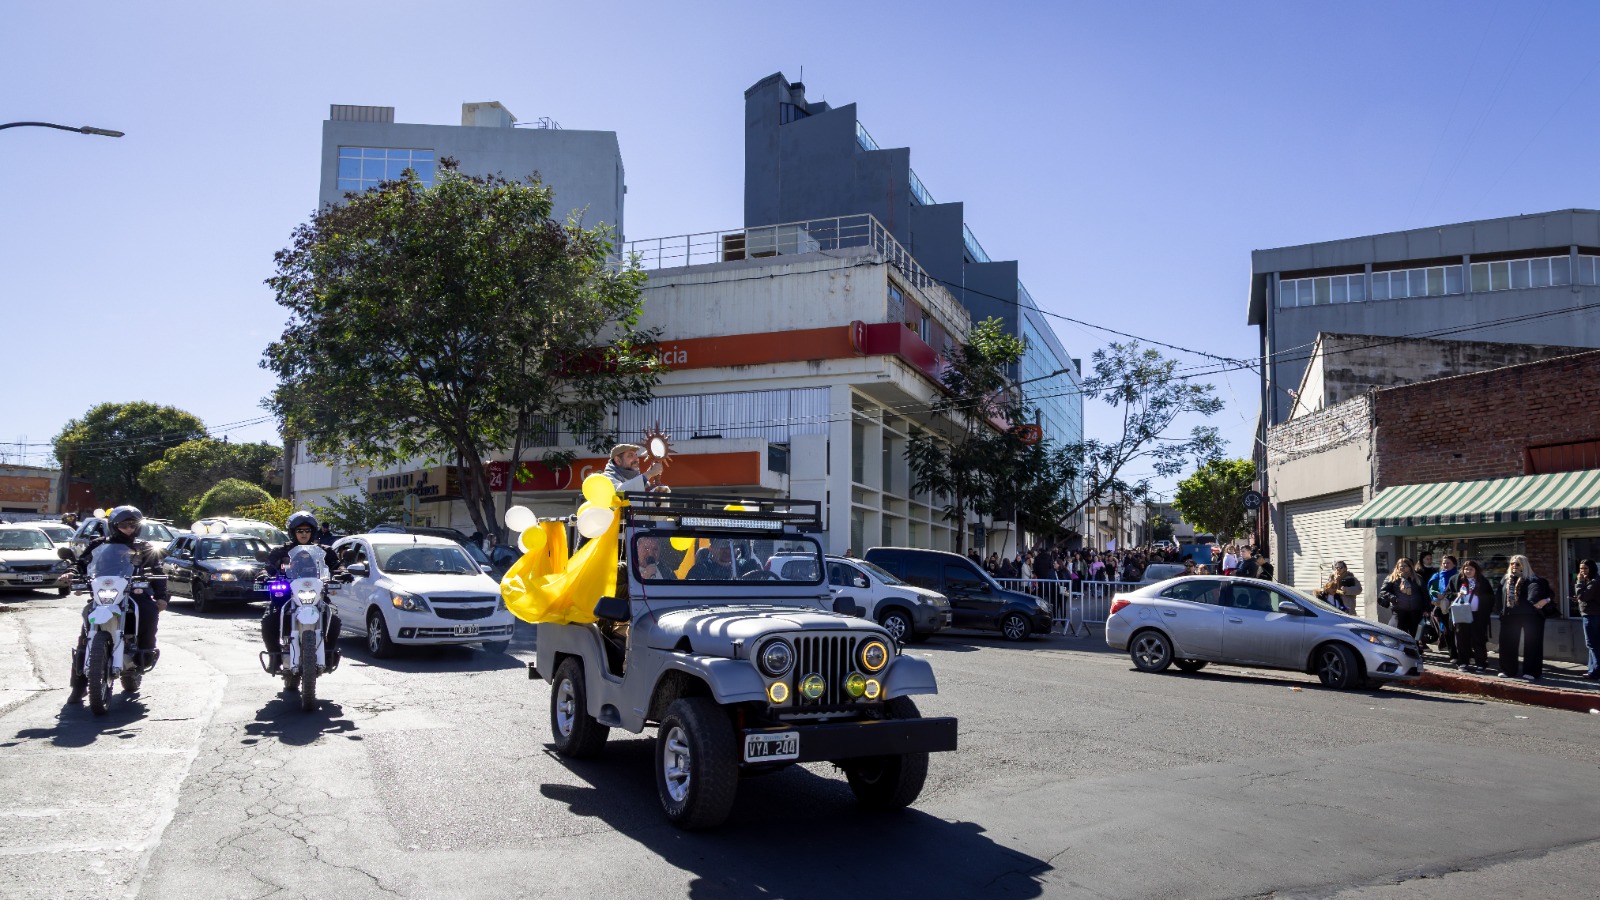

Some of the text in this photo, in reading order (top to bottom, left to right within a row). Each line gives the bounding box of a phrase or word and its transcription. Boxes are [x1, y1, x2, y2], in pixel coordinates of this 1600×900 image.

[489, 472, 503, 487] 24
[749, 740, 796, 756] VYA 244
